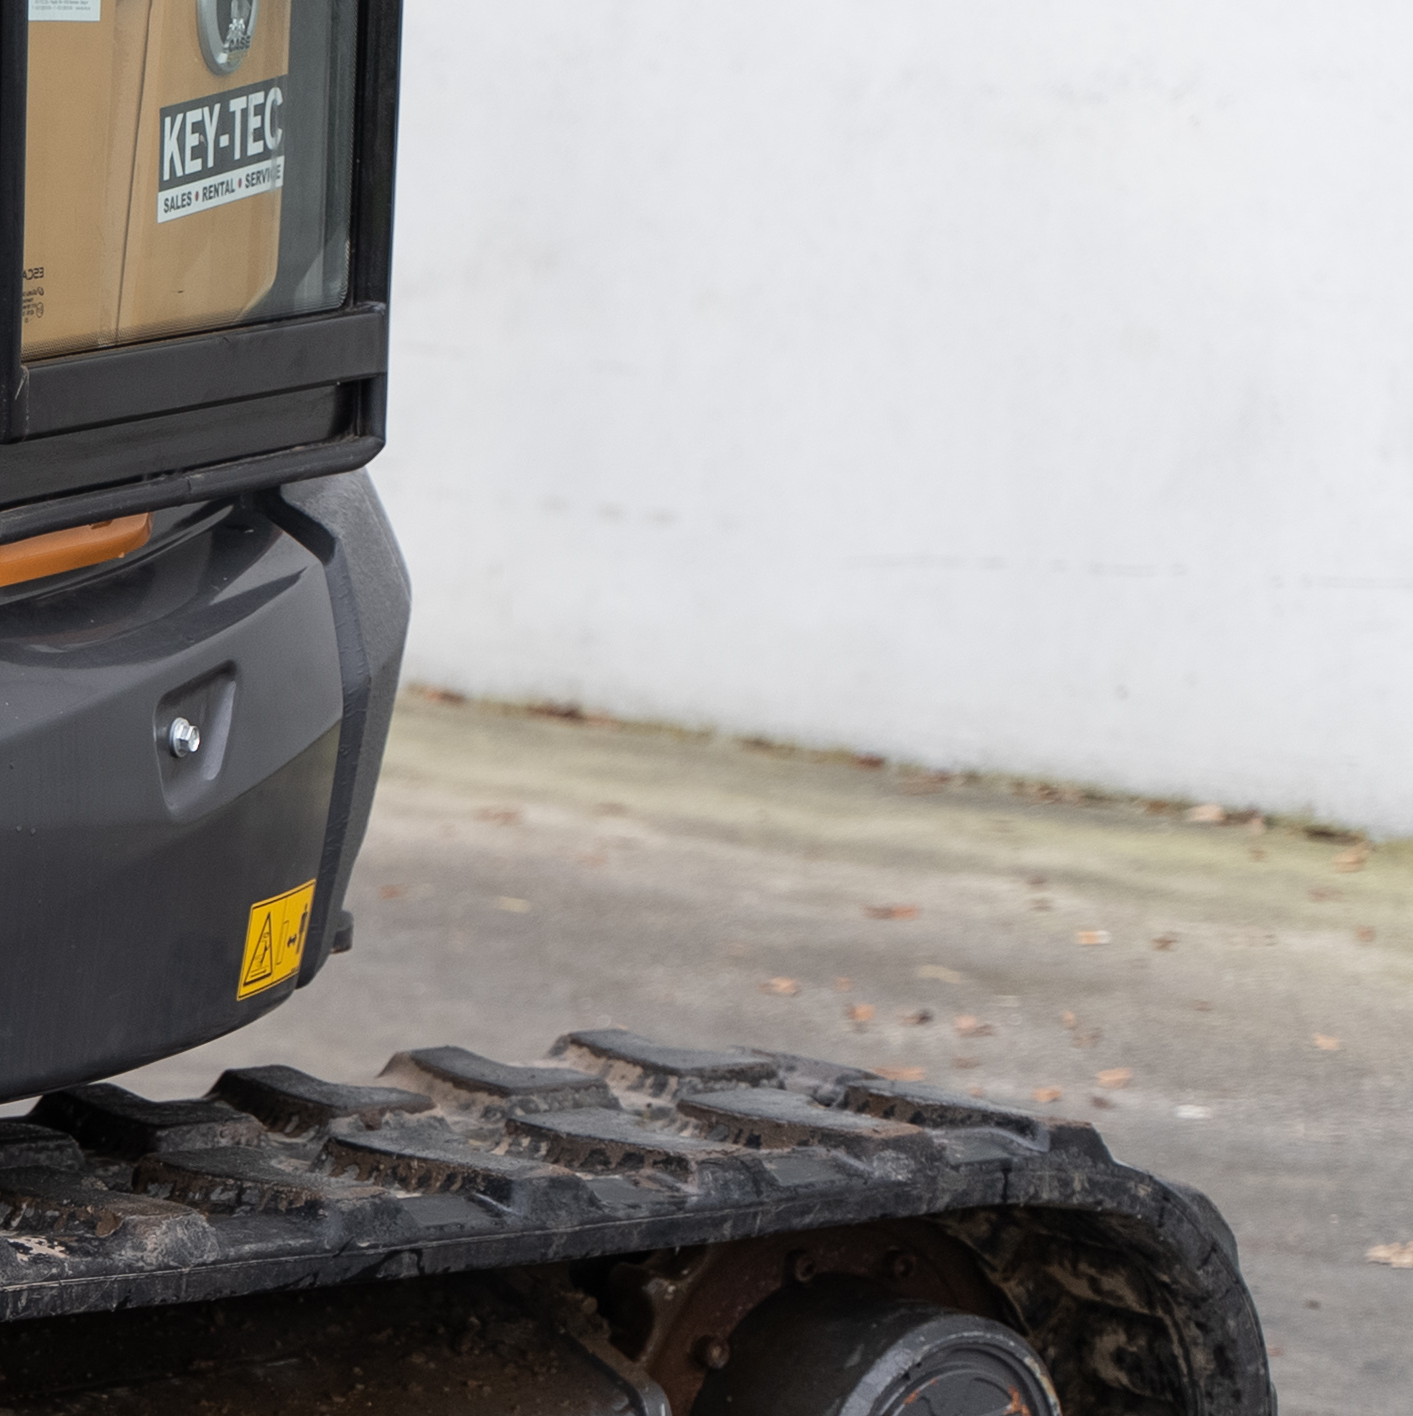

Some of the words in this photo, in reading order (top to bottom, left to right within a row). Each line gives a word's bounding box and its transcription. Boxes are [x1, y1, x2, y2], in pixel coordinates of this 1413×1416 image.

[163, 87, 283, 181] KEY-TEC
[163, 191, 192, 213] SALES
[202, 178, 235, 202] RENTAL
[245, 164, 281, 188] SERVIE
